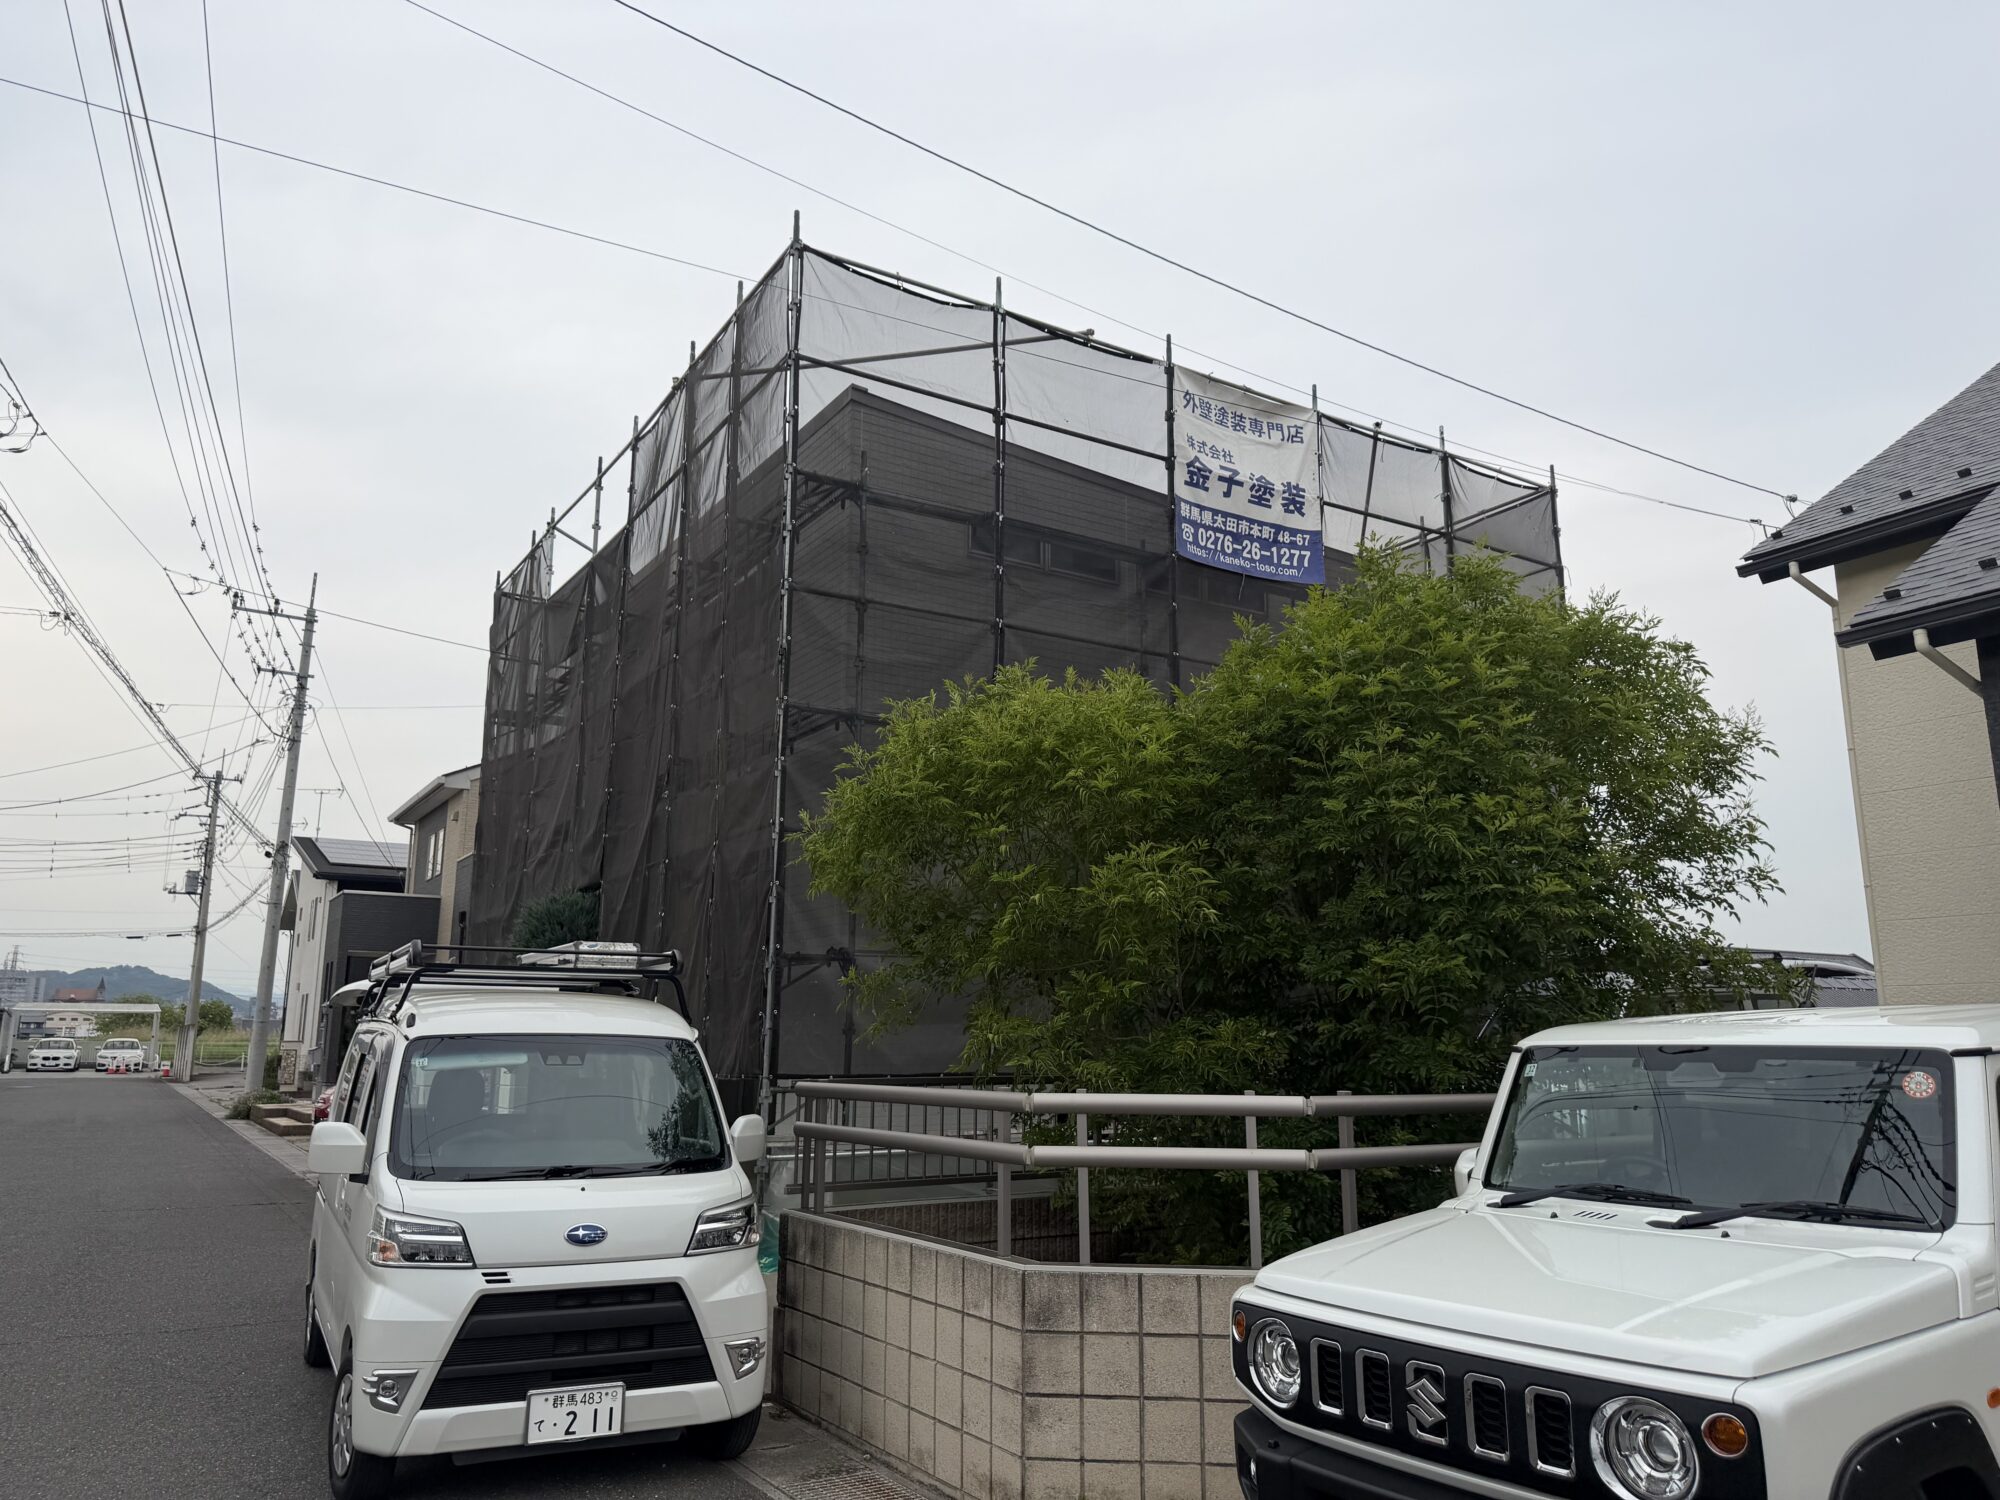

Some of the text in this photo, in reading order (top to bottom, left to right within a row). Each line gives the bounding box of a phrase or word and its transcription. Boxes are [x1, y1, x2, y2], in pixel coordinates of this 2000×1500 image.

[1183, 389, 1304, 444] 外壁塗装専門店
[1186, 433, 1235, 465] 株式会社
[1184, 456, 1306, 518] 金子塗装
[1180, 502, 1275, 542] 群馬県太田市本町
[1187, 543, 1304, 577] https://kaneko-toso.com/
[1198, 527, 1311, 568] 0276-26-1277
[552, 1391, 603, 1408] 群馬 483
